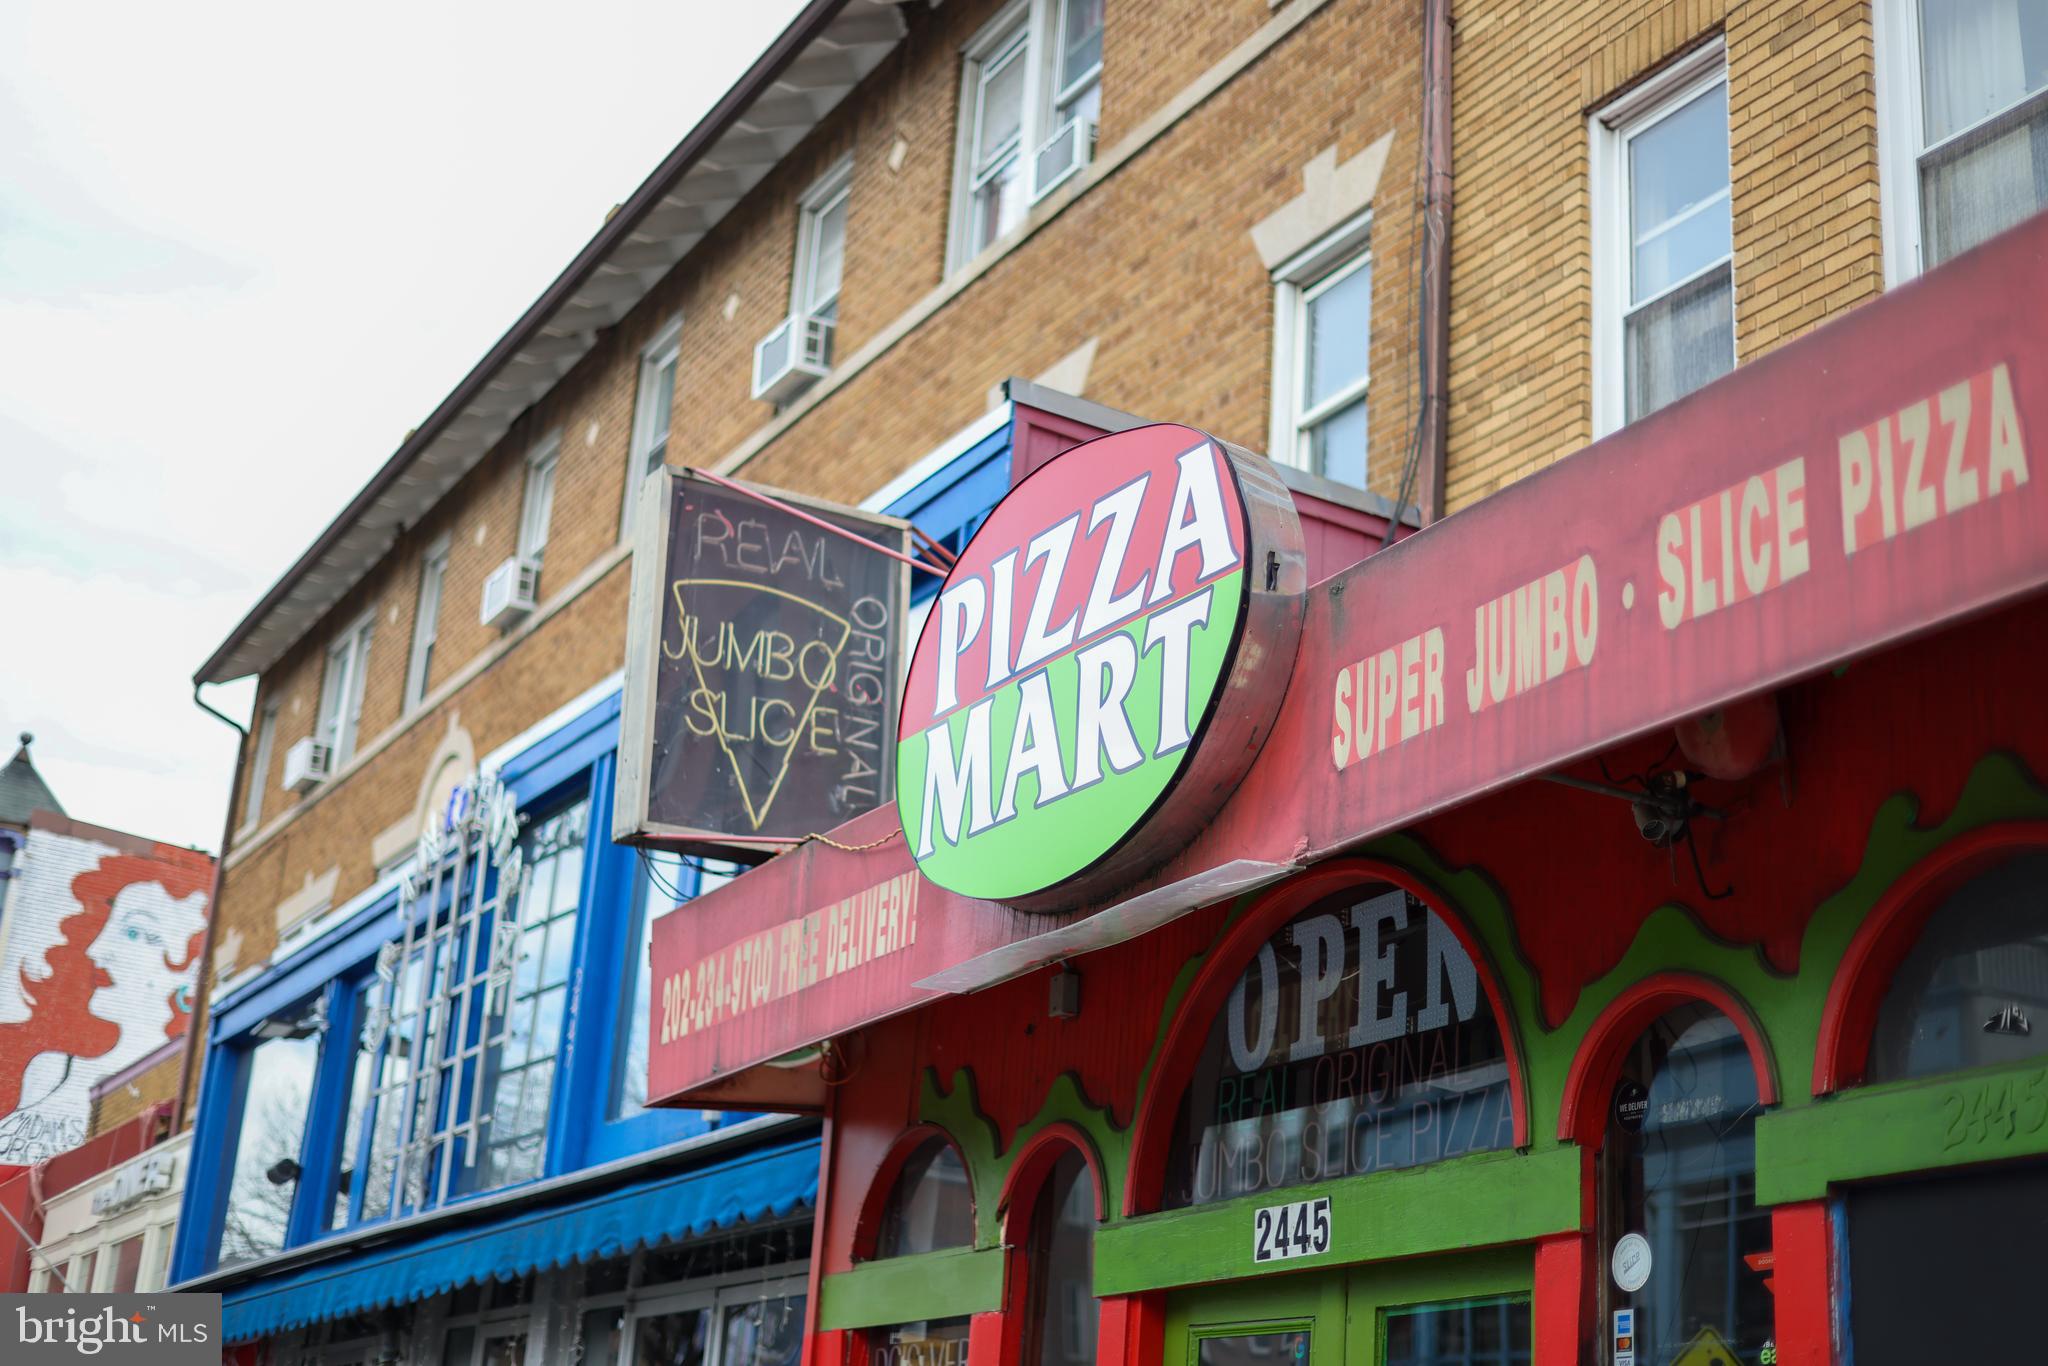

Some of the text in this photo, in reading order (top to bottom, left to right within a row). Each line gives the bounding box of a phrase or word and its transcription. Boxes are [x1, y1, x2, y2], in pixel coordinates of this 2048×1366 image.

[694, 512, 844, 590] REAL
[933, 438, 1241, 719] PIZZA
[1332, 626, 1445, 772] SUPER
[1467, 553, 1599, 713] JUMBO
[1657, 456, 1811, 631] SLICE
[1837, 362, 2030, 556] PIZZA
[663, 615, 837, 691] JUMBO
[841, 595, 889, 804] ORIGINAL
[685, 688, 839, 755] SLICE
[916, 584, 1215, 862] MART
[777, 913, 822, 997] FREE
[825, 869, 920, 979] DELIVERY!
[1227, 888, 1478, 1073] OPEN
[1216, 1024, 1473, 1134] REAL ORIGINAL
[1619, 1102, 1628, 1113] WE
[1628, 1100, 1648, 1112] DELIVER
[1942, 1068, 2048, 1152] 2445
[1181, 1078, 1513, 1201] JUMBO SLICE PIZZA
[1256, 1200, 1330, 1260] 2445
